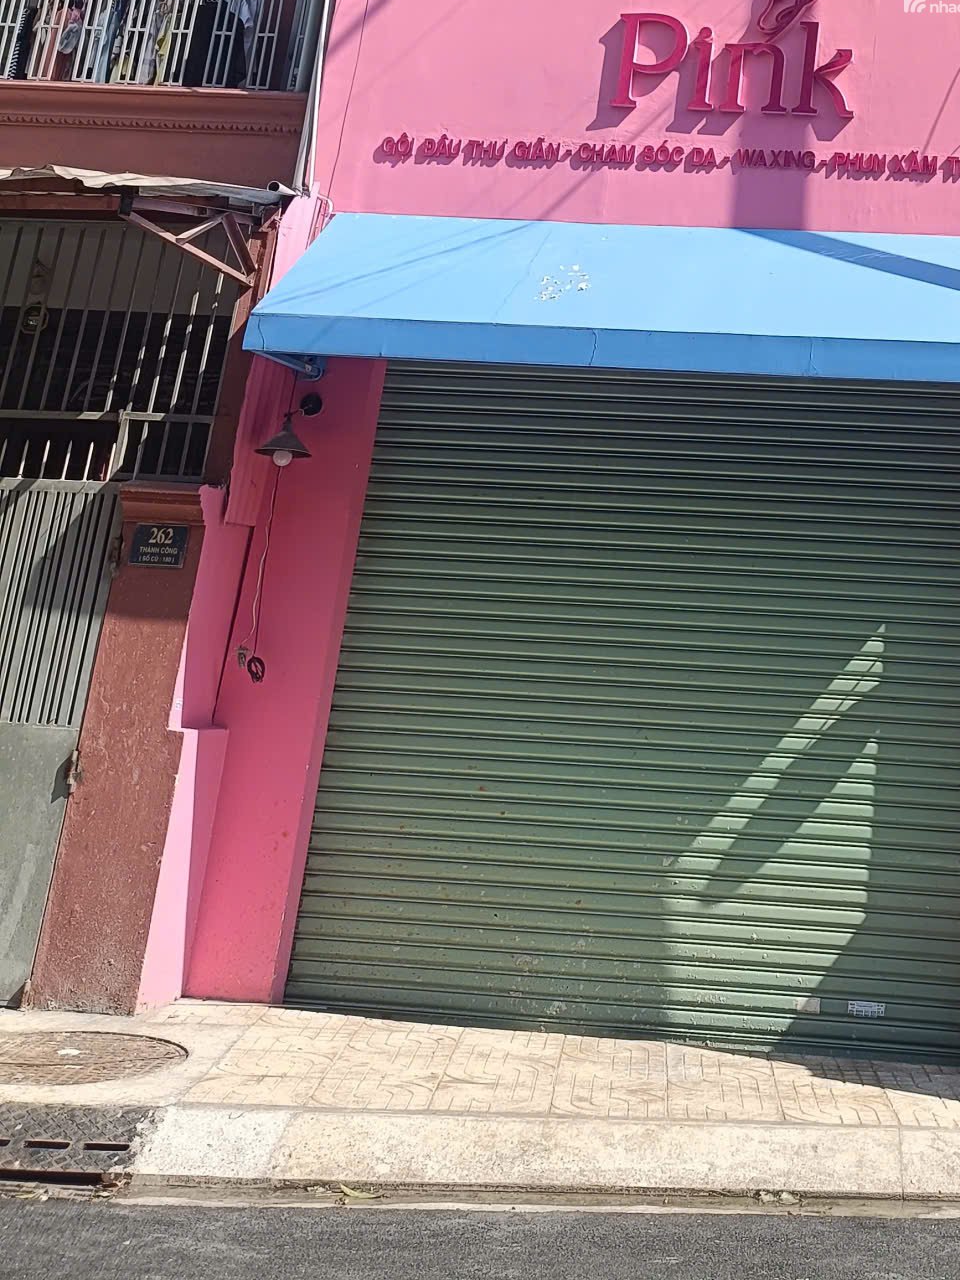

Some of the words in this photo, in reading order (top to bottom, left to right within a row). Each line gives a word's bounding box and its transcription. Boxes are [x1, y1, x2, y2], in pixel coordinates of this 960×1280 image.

[608, 12, 856, 119] Pink
[514, 137, 561, 162] GIÃN
[643, 140, 685, 165] SÓC
[690, 147, 718, 167] DA
[737, 148, 818, 170] WAXING
[834, 152, 887, 173] PHUN
[148, 527, 174, 544] 262
[160, 547, 178, 555] CÔNG
